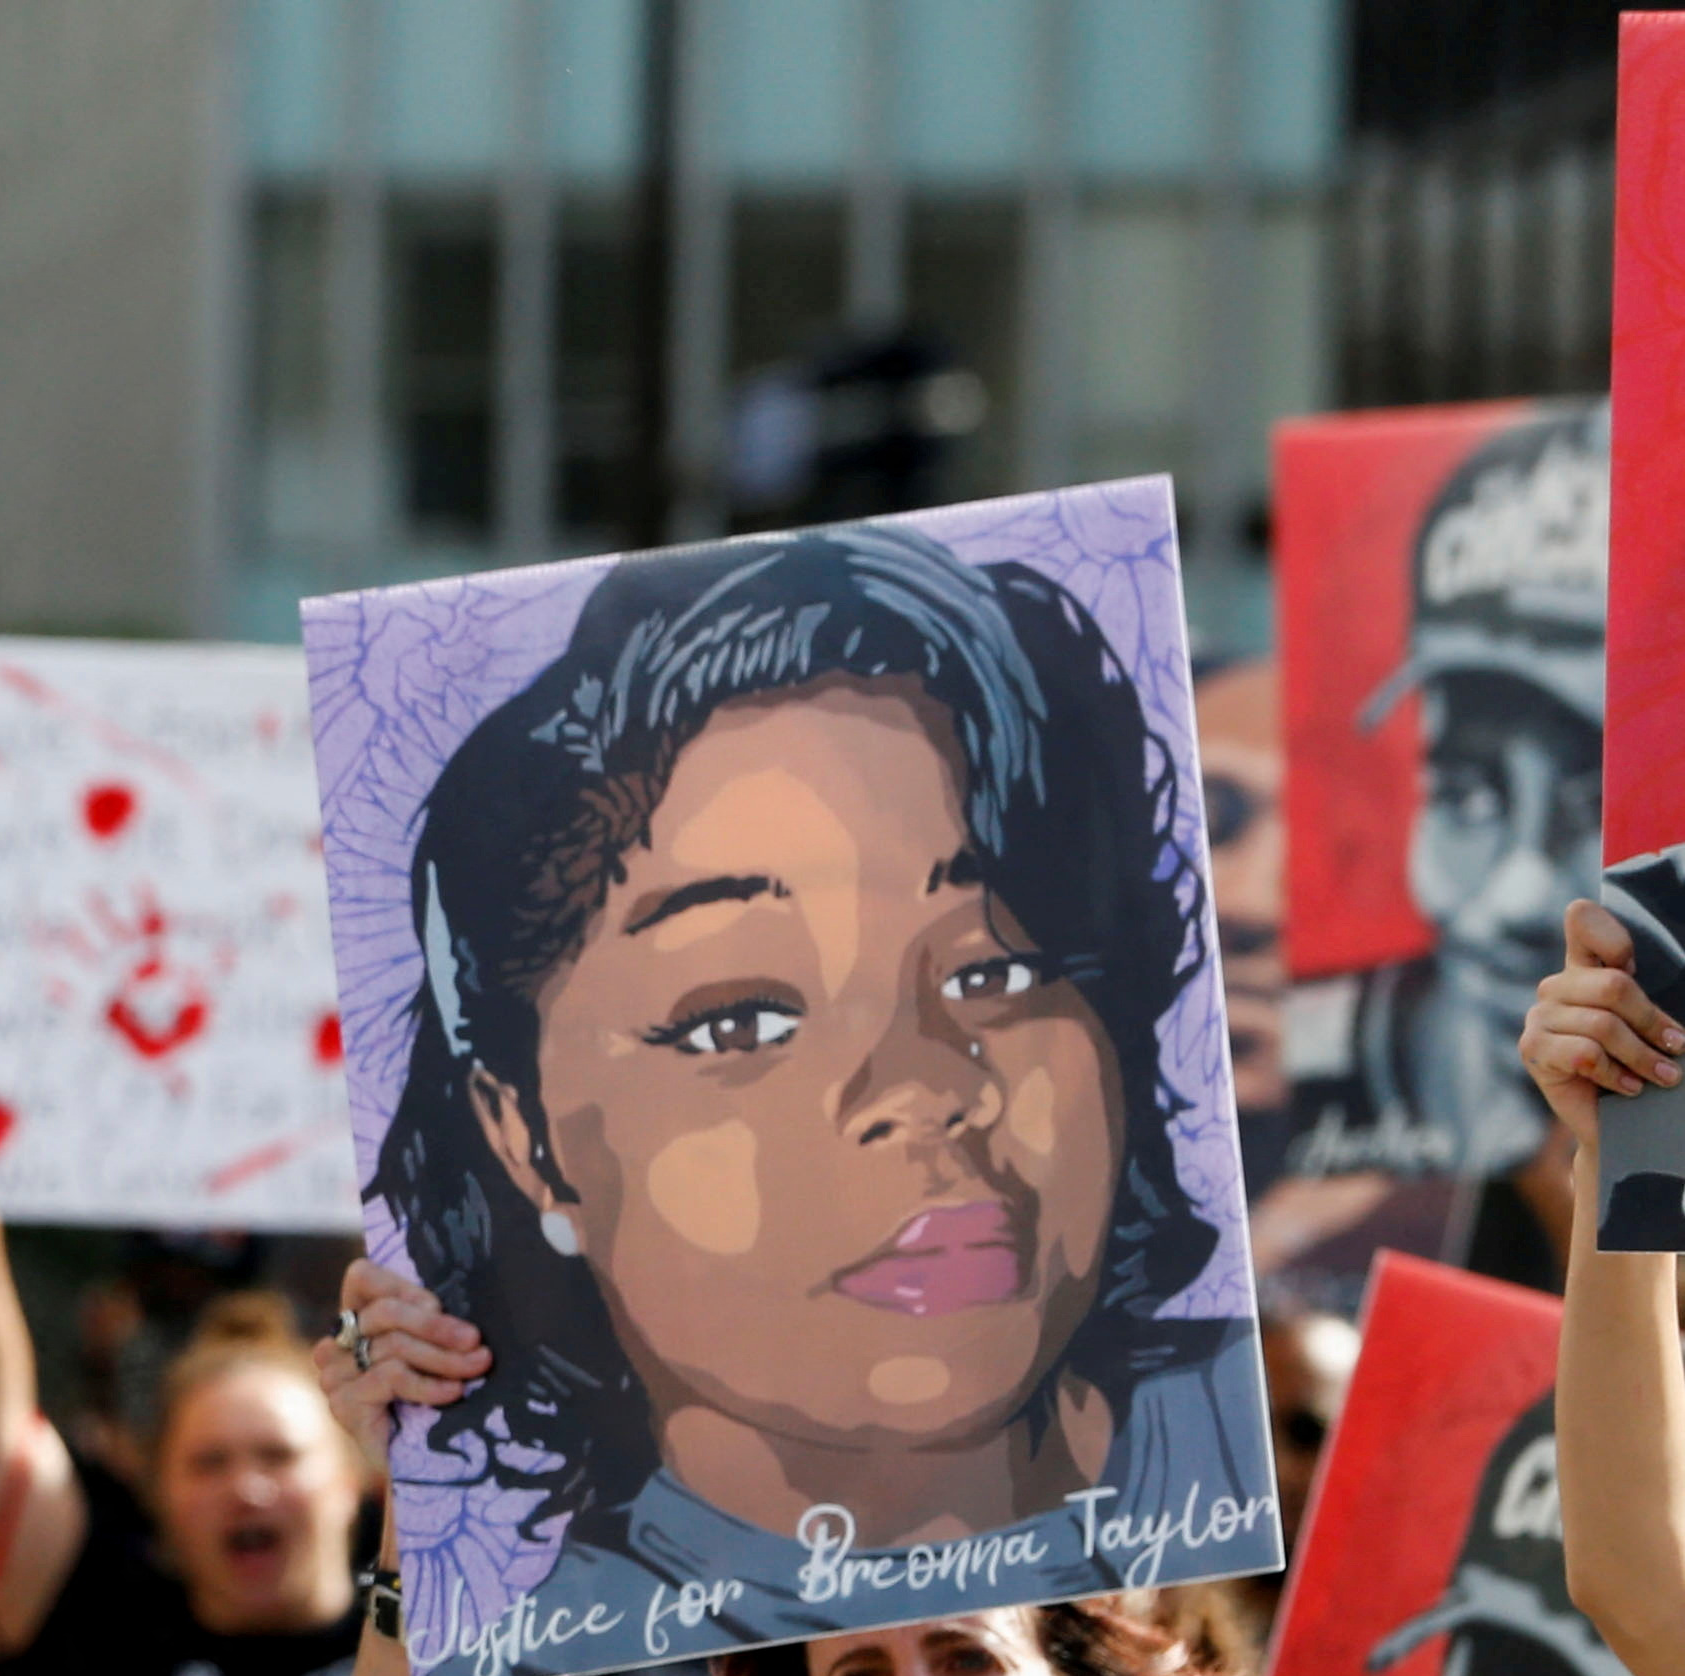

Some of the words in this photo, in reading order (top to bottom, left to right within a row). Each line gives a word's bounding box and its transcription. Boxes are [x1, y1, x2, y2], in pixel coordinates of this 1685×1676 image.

[643, 1576, 746, 1657] for
[796, 1501, 1050, 1604] Breonna
[1062, 1480, 1278, 1590] Taylor
